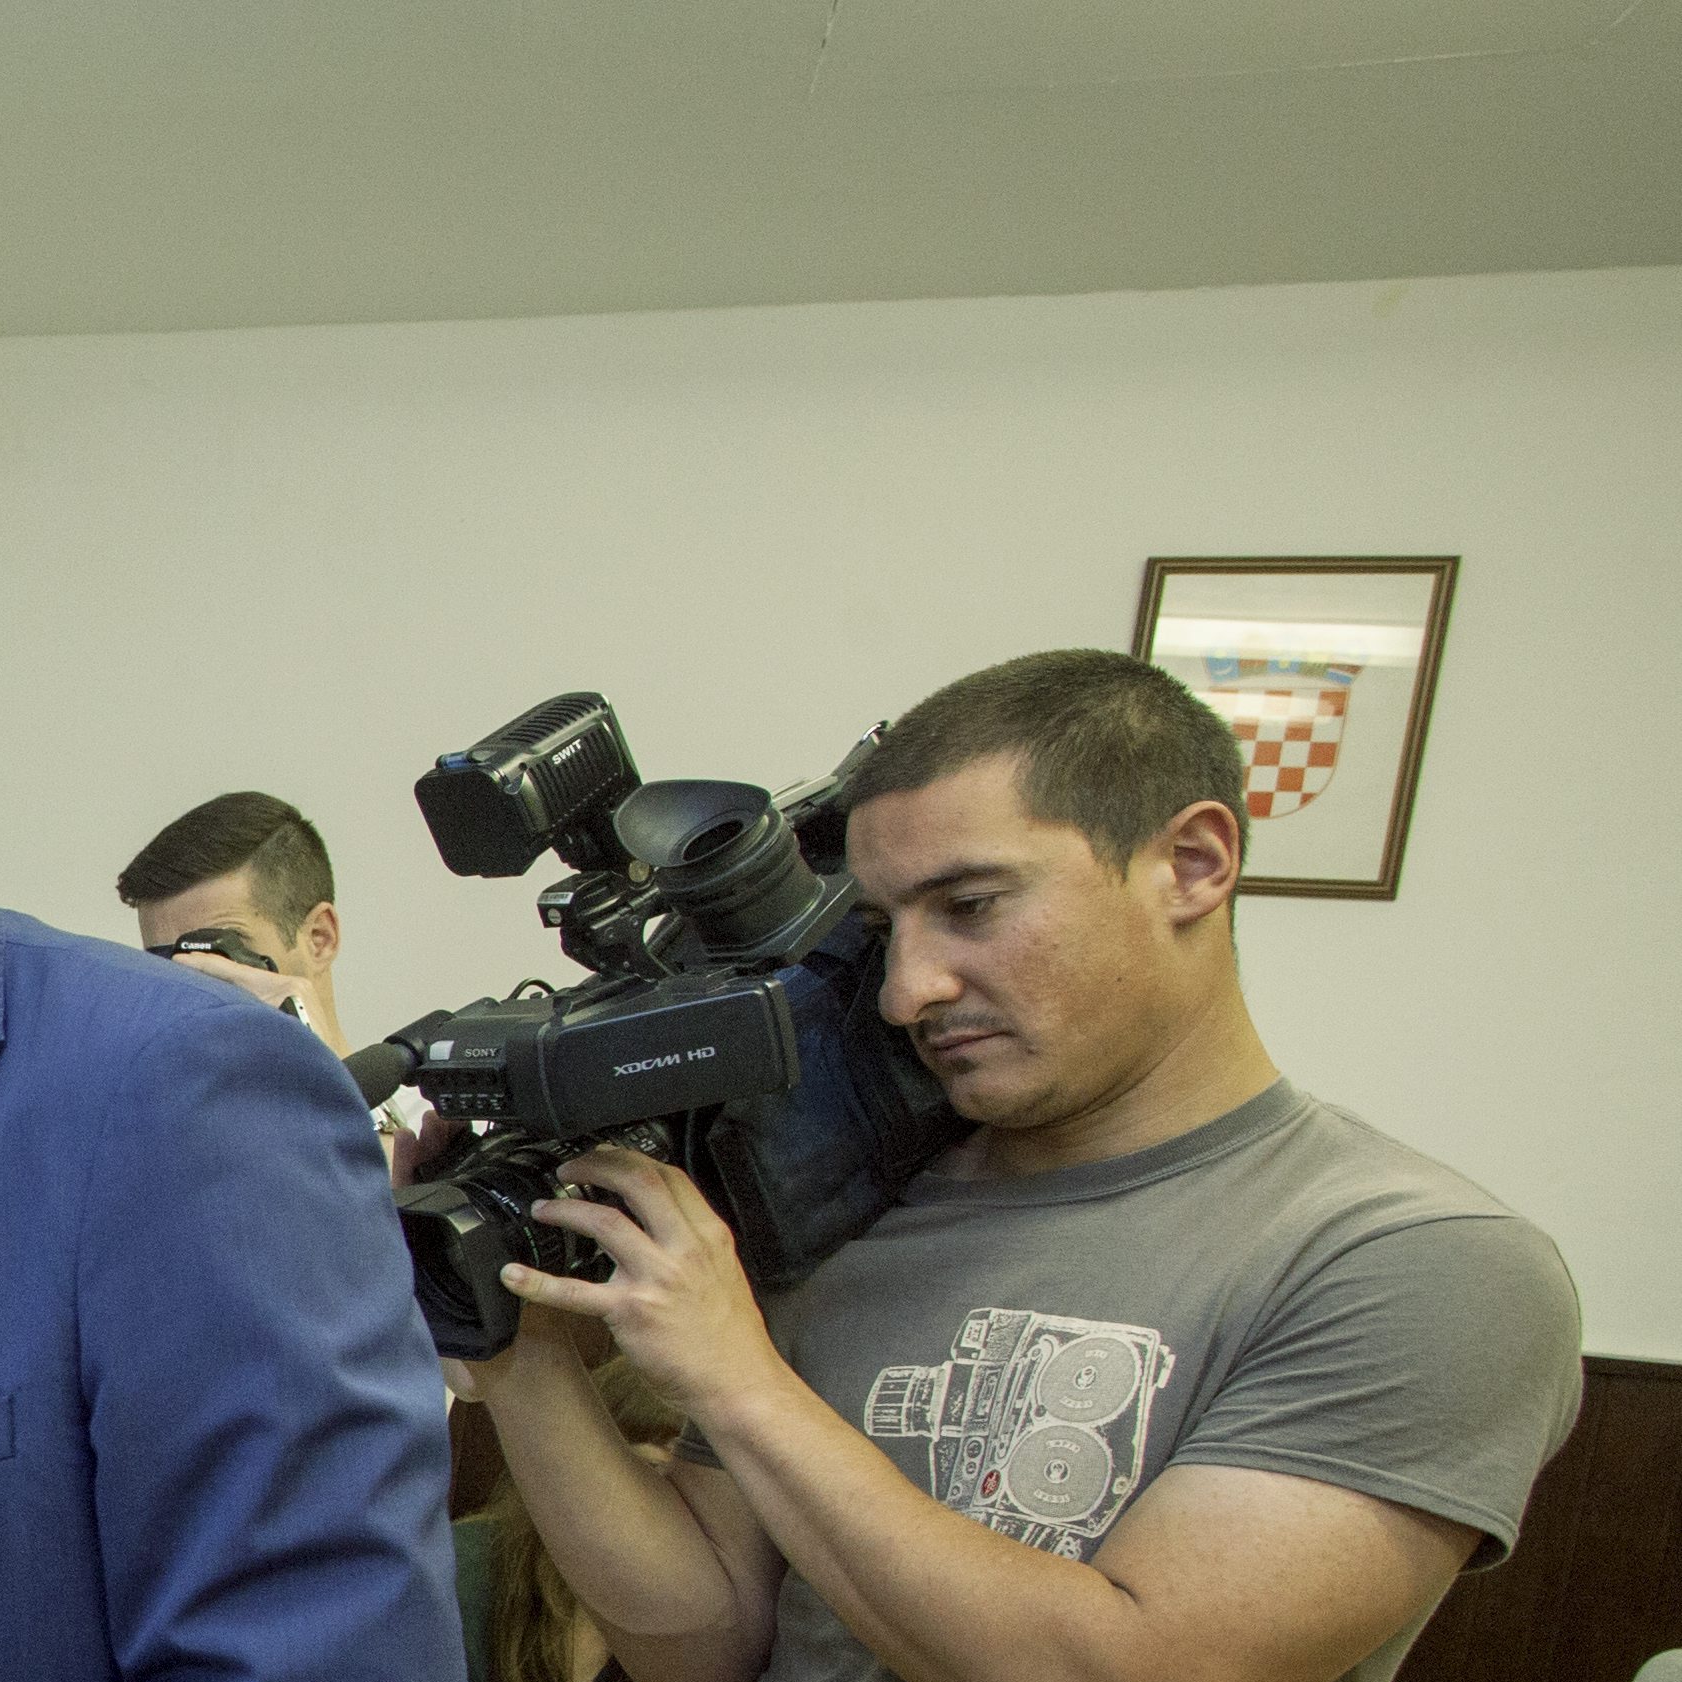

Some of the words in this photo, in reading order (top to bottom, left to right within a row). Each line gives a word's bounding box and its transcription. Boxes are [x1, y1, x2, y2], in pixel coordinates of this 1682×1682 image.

[552, 738, 581, 765] SWIT
[181, 941, 212, 950] Canon
[464, 1047, 499, 1058] SONY
[686, 1045, 716, 1062] HD
